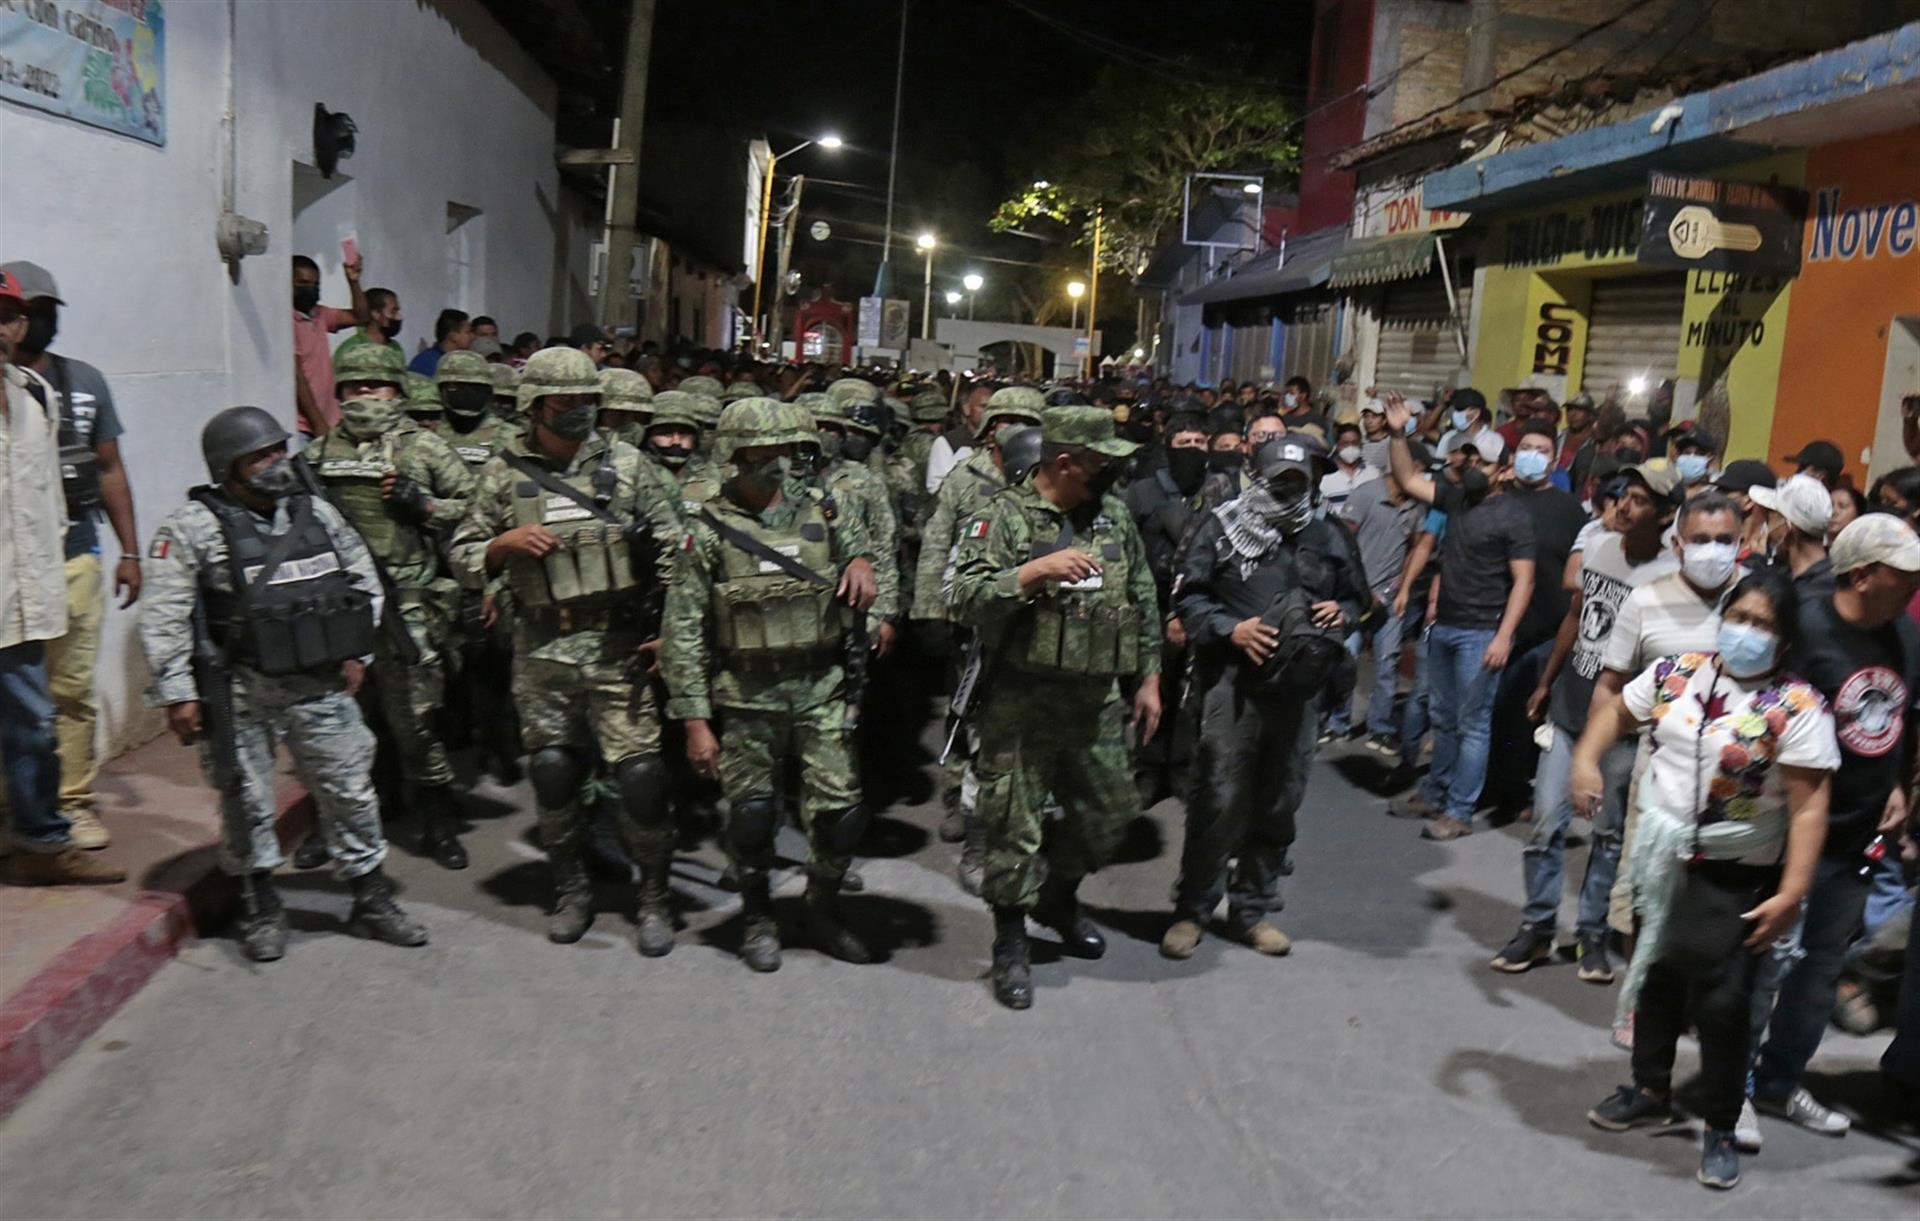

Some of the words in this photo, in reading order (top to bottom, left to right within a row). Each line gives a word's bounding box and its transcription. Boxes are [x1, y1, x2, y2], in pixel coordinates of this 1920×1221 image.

[1385, 193, 1421, 234] DON
[1808, 186, 1919, 262] Nove
[1532, 303, 1575, 375] COM
[1686, 319, 1764, 347] MINUTO
